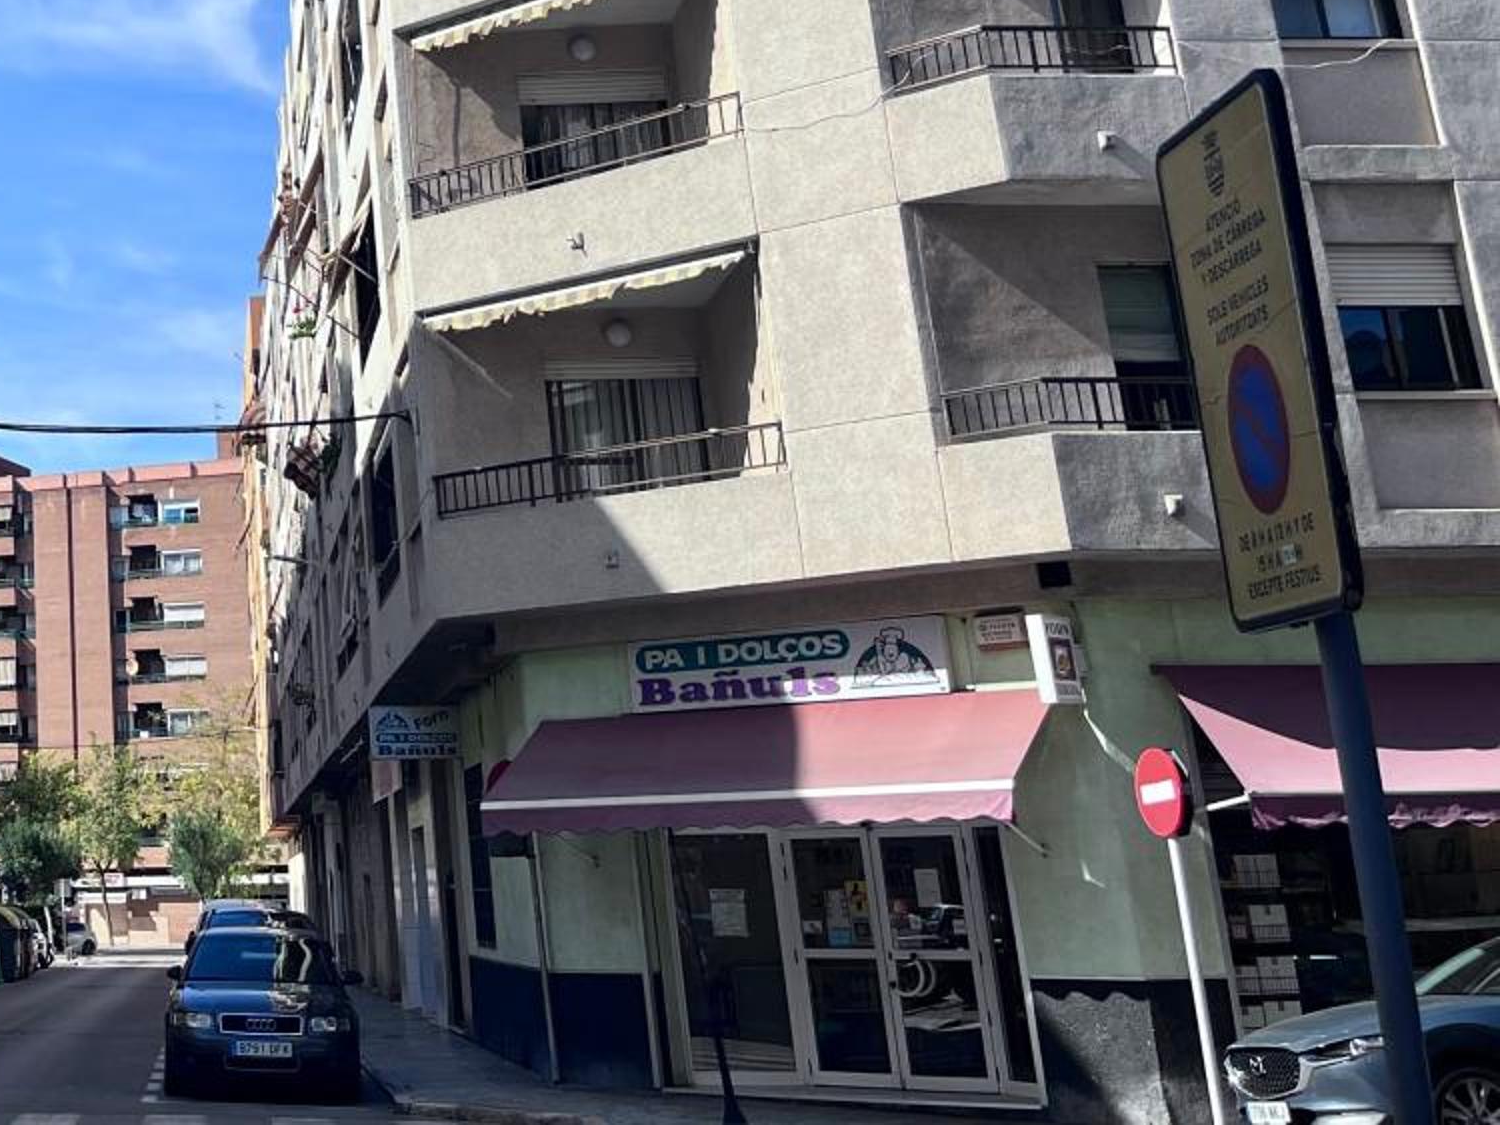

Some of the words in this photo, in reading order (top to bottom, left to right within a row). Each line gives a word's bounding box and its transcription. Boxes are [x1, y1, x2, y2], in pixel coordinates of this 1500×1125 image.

[1190, 244, 1212, 269] ZONA
[1212, 234, 1225, 254] DE
[1207, 299, 1227, 326] SOLS
[1228, 274, 1269, 311] VEHICLES
[644, 648, 684, 670] PA
[698, 645, 706, 666] I
[718, 634, 843, 662] DOLÇOS
[638, 667, 840, 705] Bañuls
